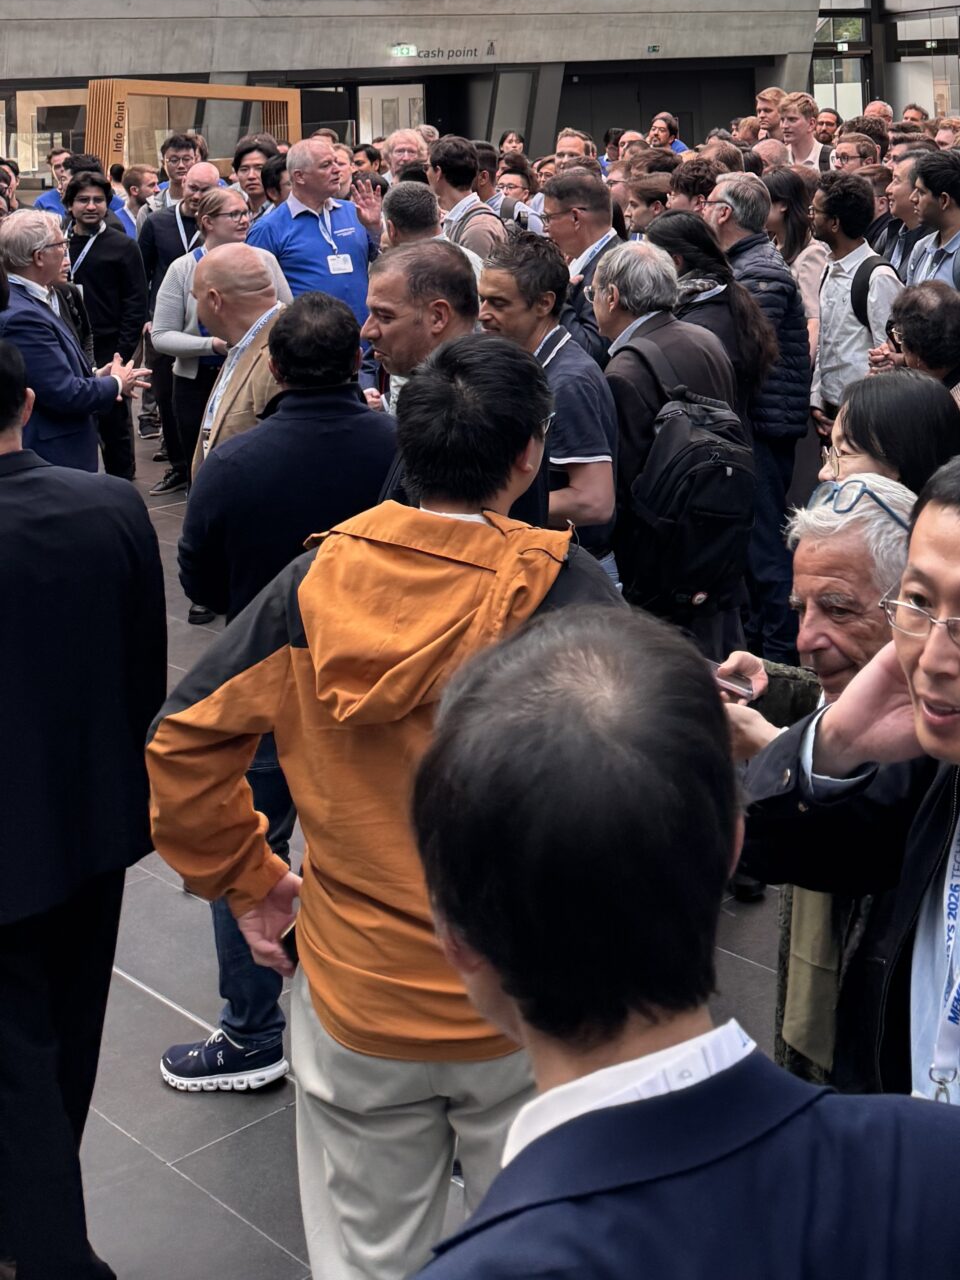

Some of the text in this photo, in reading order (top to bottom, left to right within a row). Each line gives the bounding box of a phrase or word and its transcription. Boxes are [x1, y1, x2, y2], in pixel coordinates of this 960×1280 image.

[417, 47, 478, 60] cash point
[113, 101, 125, 152] Info Point
[947, 883, 960, 920] 2026
